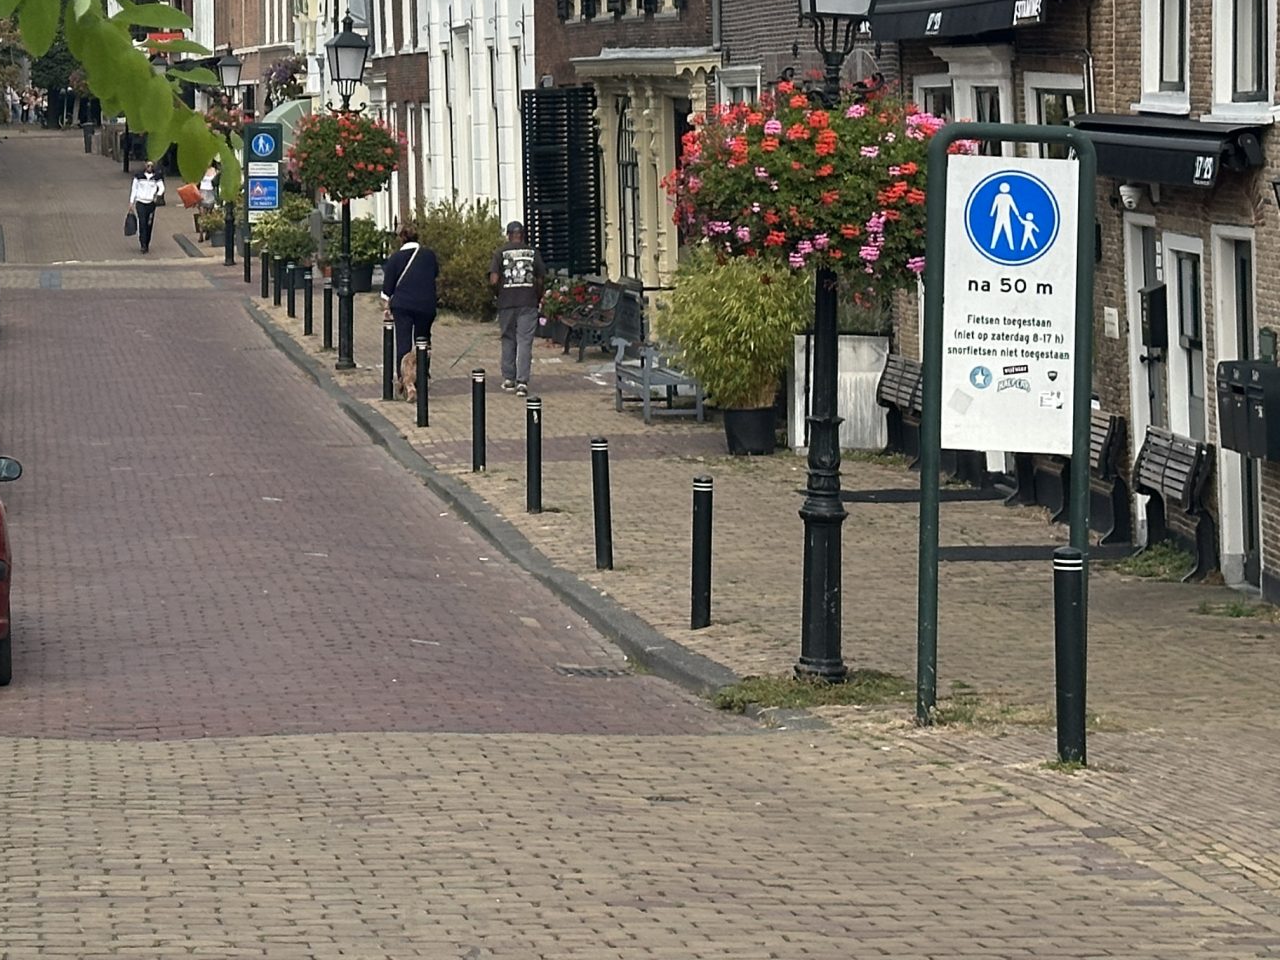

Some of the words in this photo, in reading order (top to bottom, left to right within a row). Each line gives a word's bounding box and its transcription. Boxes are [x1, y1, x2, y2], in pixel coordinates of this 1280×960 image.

[968, 279, 991, 292] na
[1000, 277, 1027, 294] 50
[1036, 283, 1053, 295] m
[967, 314, 1000, 325] Fietsen
[1003, 316, 1052, 329] toegestaan
[954, 328, 975, 340] (niet
[977, 331, 988, 342] op
[991, 331, 1030, 345] zaterdag
[1032, 333, 1052, 343] 8-17
[1055, 333, 1065, 344] h)
[947, 345, 998, 357] snorfietsen
[1000, 347, 1018, 358] niet
[1021, 348, 1070, 361] toegestaan
